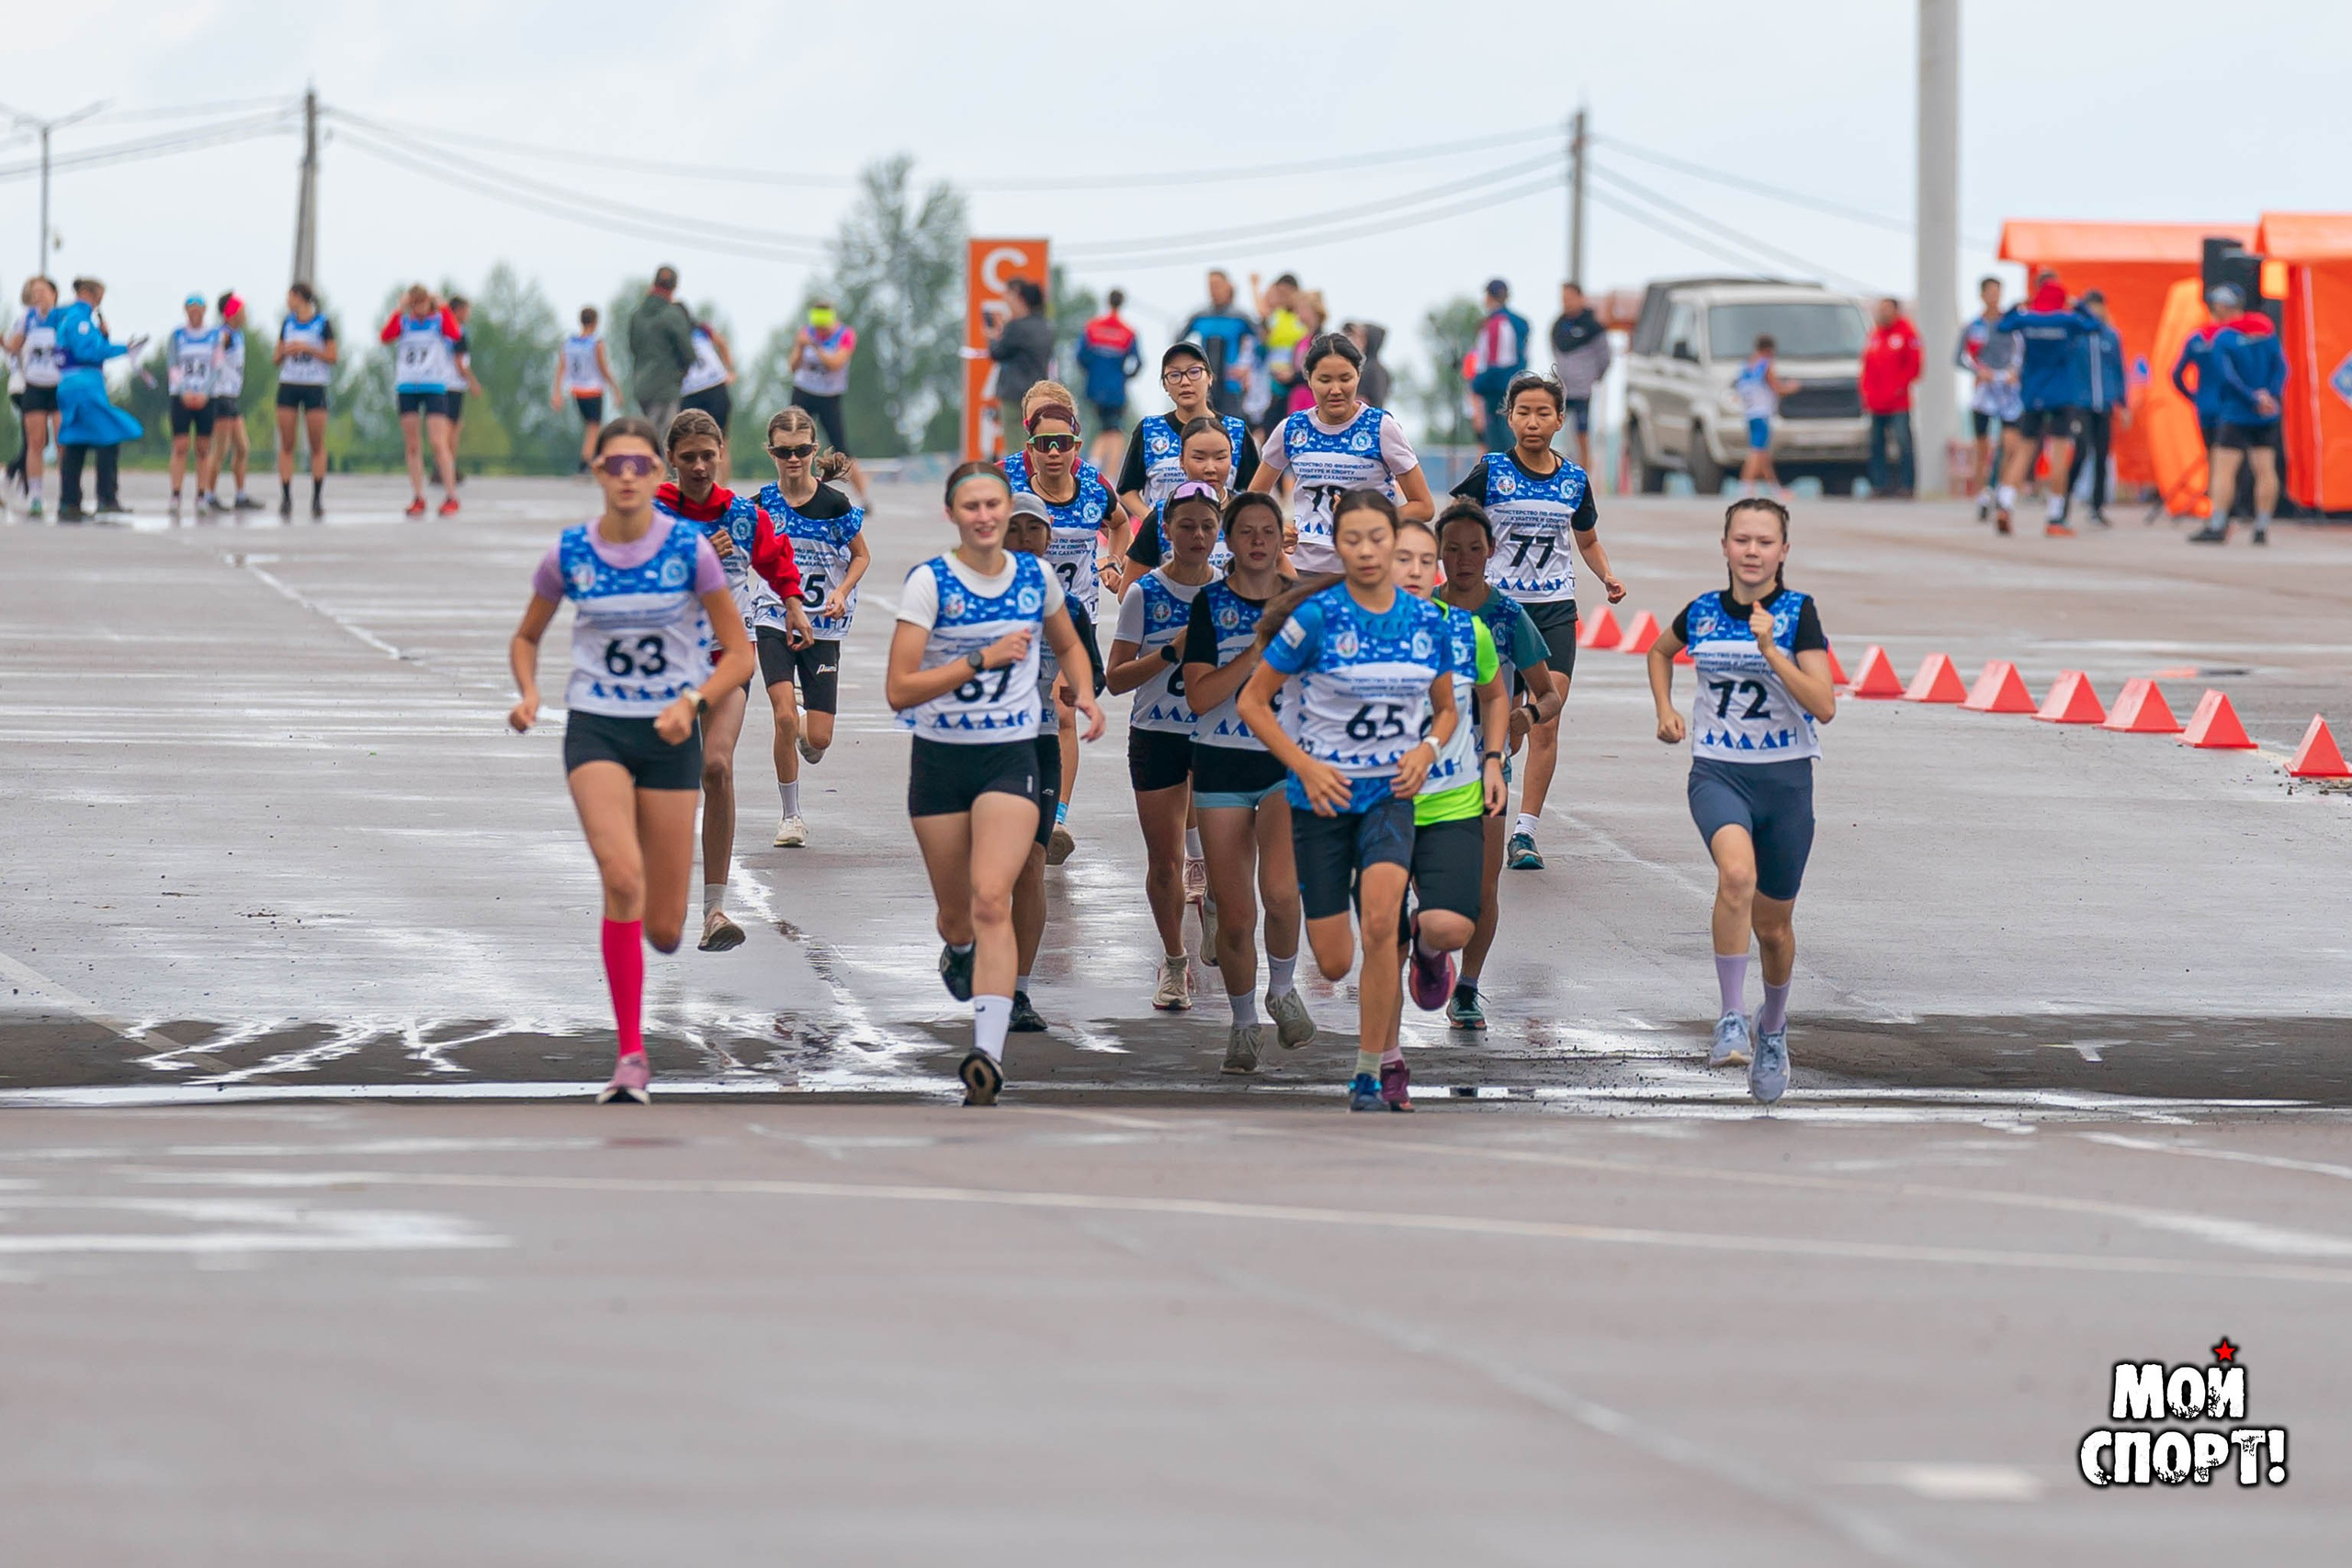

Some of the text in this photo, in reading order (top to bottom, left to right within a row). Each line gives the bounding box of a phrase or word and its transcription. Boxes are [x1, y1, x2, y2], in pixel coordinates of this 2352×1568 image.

[1510, 533, 1555, 569] 77
[800, 573, 826, 608] 5
[1051, 562, 1079, 592] 3
[605, 636, 666, 677] 63
[1709, 680, 1772, 720] 72
[1346, 705, 1406, 742] 65
